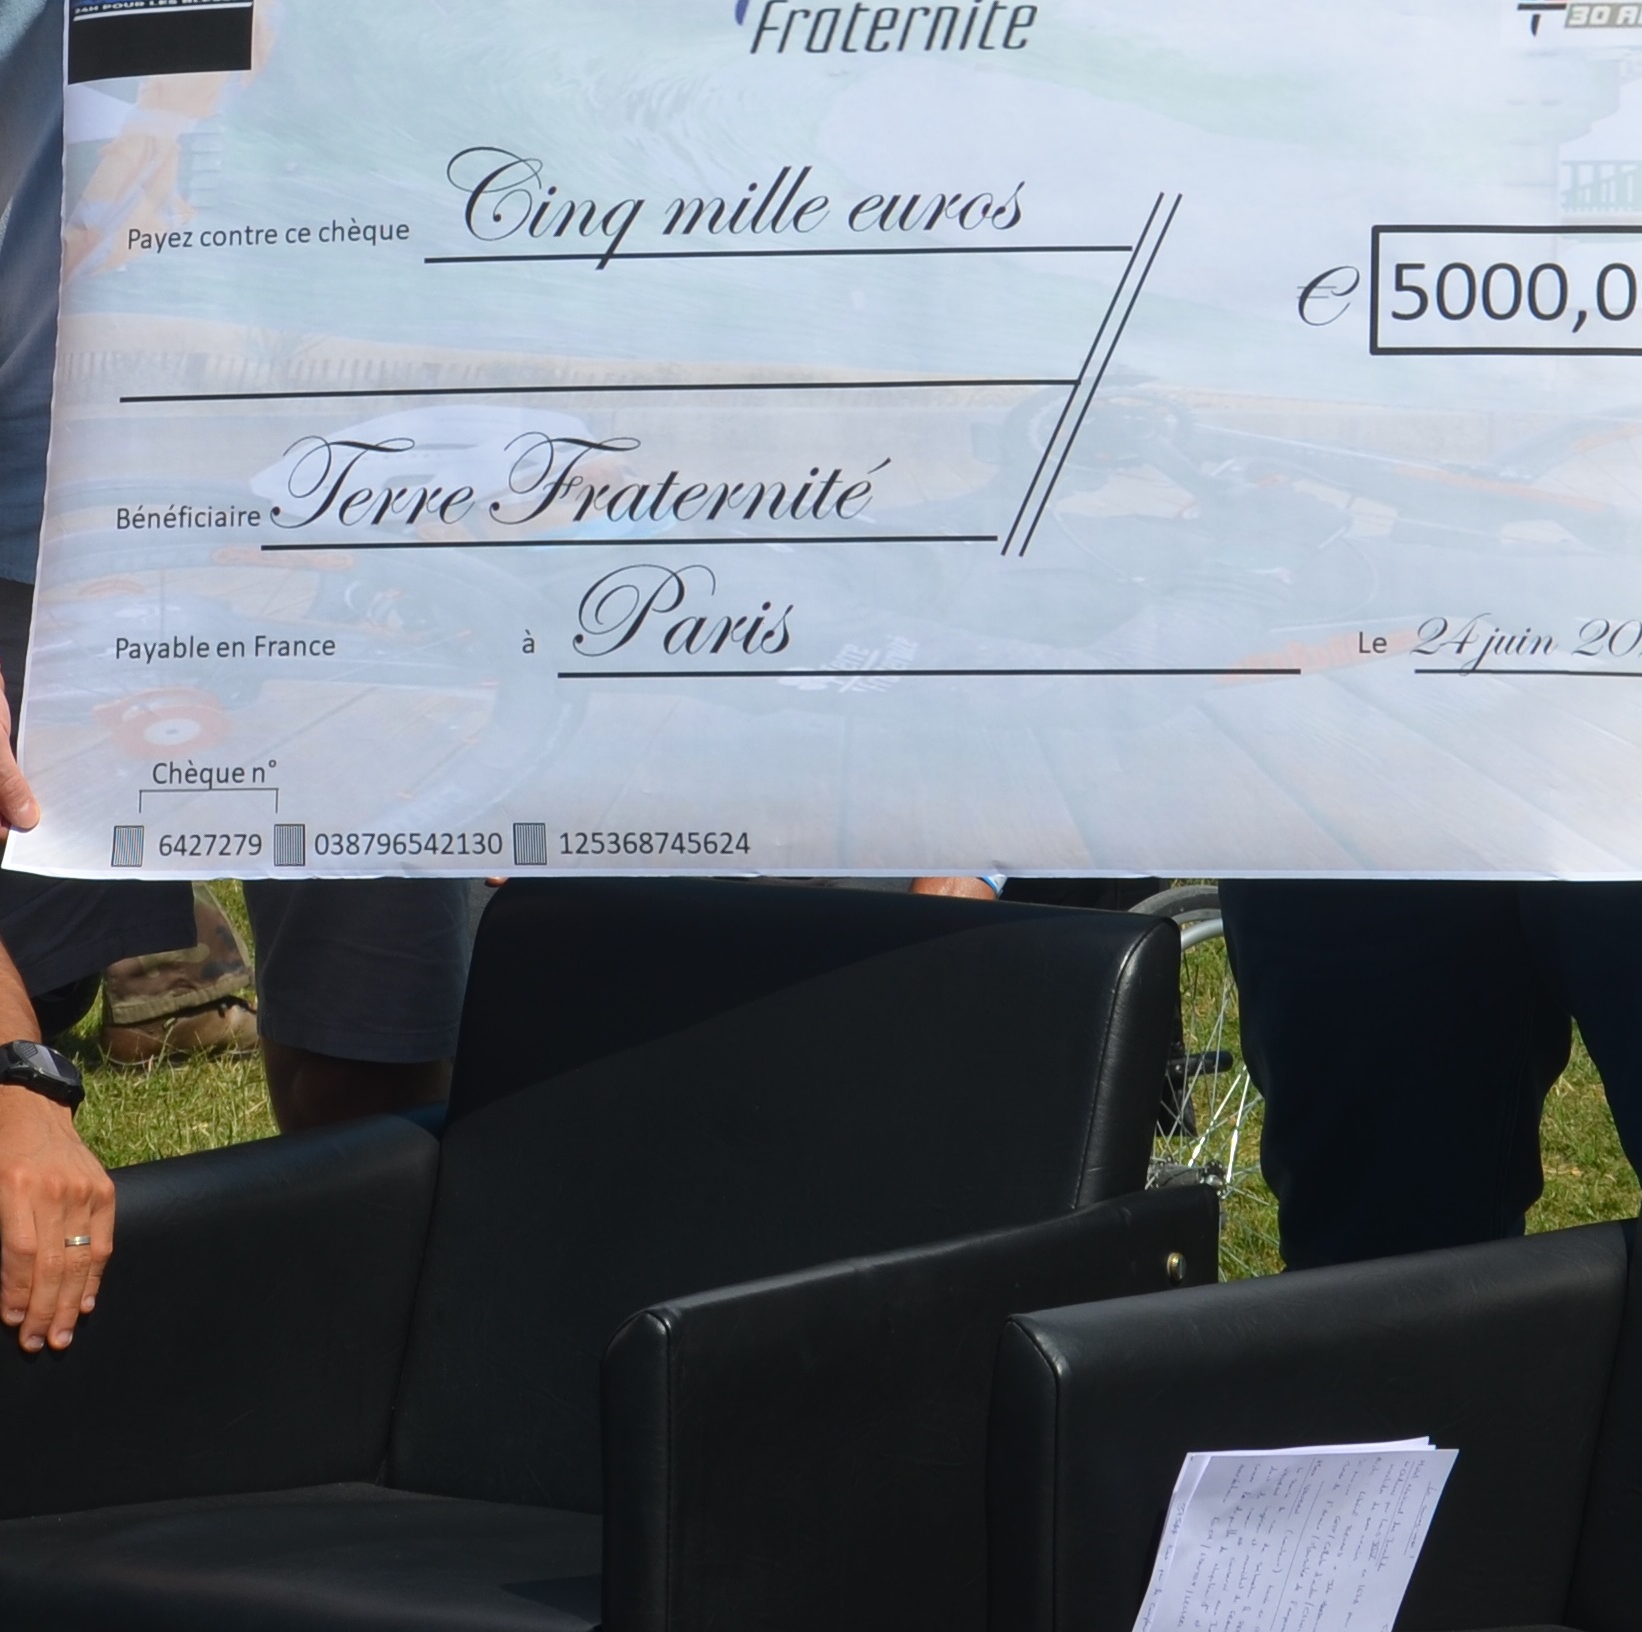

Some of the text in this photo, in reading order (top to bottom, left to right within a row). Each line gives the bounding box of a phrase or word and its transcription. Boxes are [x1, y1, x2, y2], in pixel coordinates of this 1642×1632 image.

[102, 1, 145, 11] POUR
[1568, 3, 1611, 26] 30
[446, 146, 1027, 270] Cinq mille euros
[128, 217, 410, 254] Payez contre ce chèque
[116, 430, 892, 530] Bénéficiaire Terre Fraternité
[116, 562, 794, 663] Payable en France à Paris
[1358, 630, 1388, 655] Le
[1410, 614, 1479, 659] 24
[1463, 624, 1559, 676] juin
[152, 759, 246, 790] Chèque
[158, 830, 752, 858] 6427279 038796542130 125368745624
